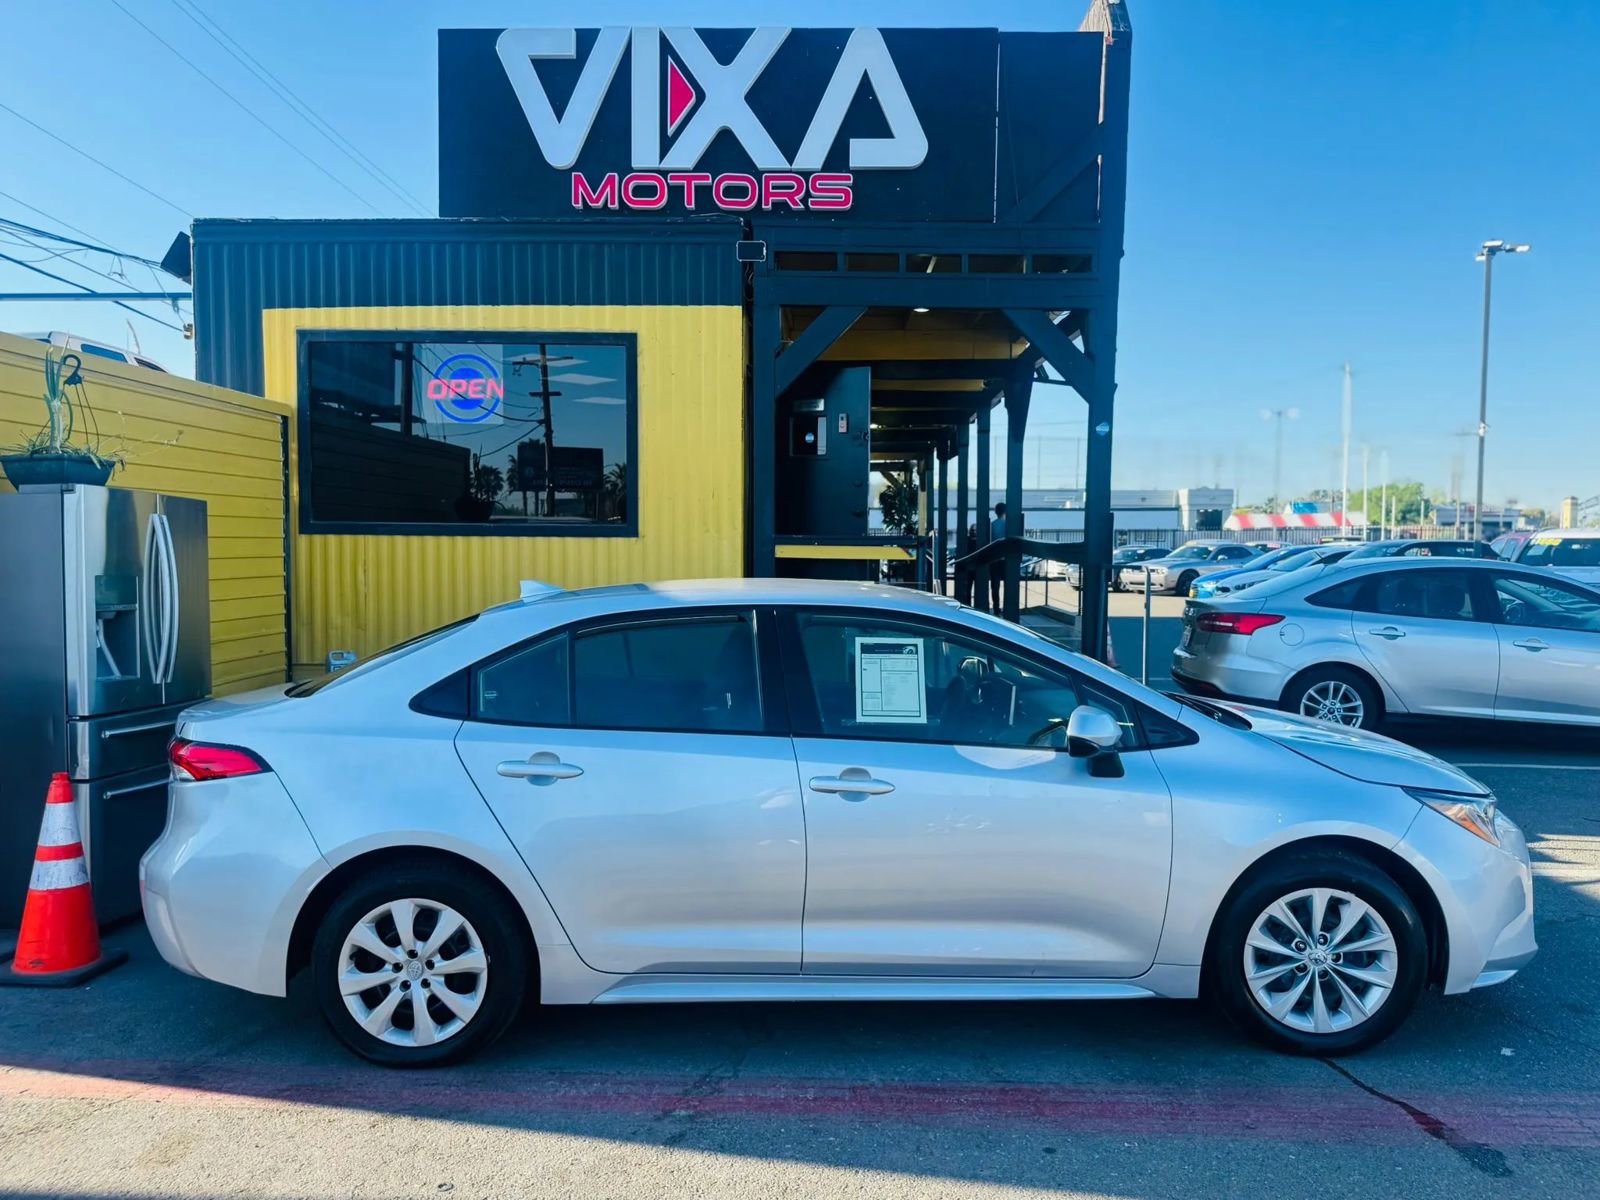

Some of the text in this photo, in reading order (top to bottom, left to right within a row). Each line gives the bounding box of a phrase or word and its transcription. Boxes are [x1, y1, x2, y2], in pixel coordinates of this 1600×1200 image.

[496, 27, 929, 171] VIXA
[570, 171, 854, 212] MOTORS
[427, 377, 505, 400] OPEN
